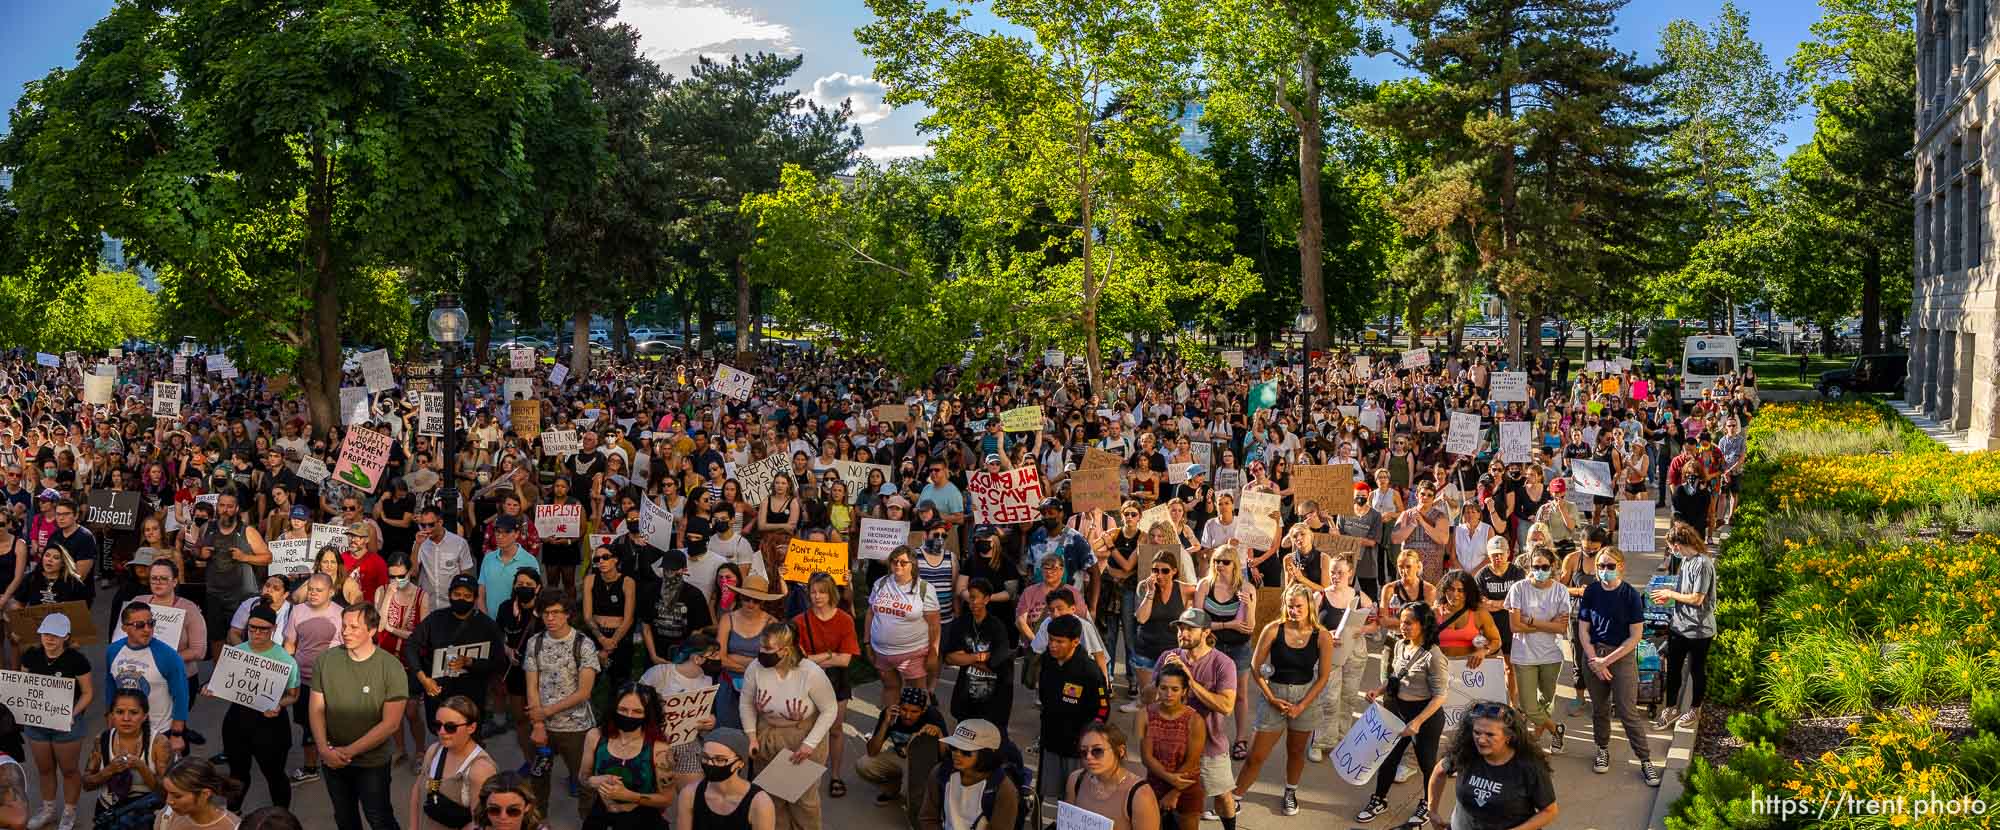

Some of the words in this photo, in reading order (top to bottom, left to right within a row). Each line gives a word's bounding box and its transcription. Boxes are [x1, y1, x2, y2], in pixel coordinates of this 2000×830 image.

[543, 433, 563, 443] HELL
[347, 438, 383, 457] WOMEN
[342, 450, 384, 471] PROPERTY
[734, 461, 761, 481] KEEP
[761, 453, 790, 471] YOUR
[848, 464, 863, 478] NO
[1018, 468, 1038, 486] MY
[109, 492, 118, 509] I
[987, 484, 1041, 506] LAWS
[86, 506, 133, 526] Dissent
[537, 503, 580, 518] RAPISTS
[313, 523, 327, 533] THEY
[328, 527, 340, 535] ARE
[281, 539, 293, 548] ARE
[285, 548, 297, 556] FOR
[892, 601, 913, 612] OUR
[223, 647, 243, 661] THEY
[242, 654, 260, 666] ARE
[260, 659, 290, 676] COMING
[1, 672, 22, 683] THEY
[23, 675, 40, 686] ARE
[41, 678, 73, 690] COMING
[245, 667, 261, 680] FOR
[1461, 670, 1485, 688] GO
[27, 688, 44, 699] FOR
[1335, 741, 1372, 781] LOVE
[1468, 775, 1504, 794] MINE
